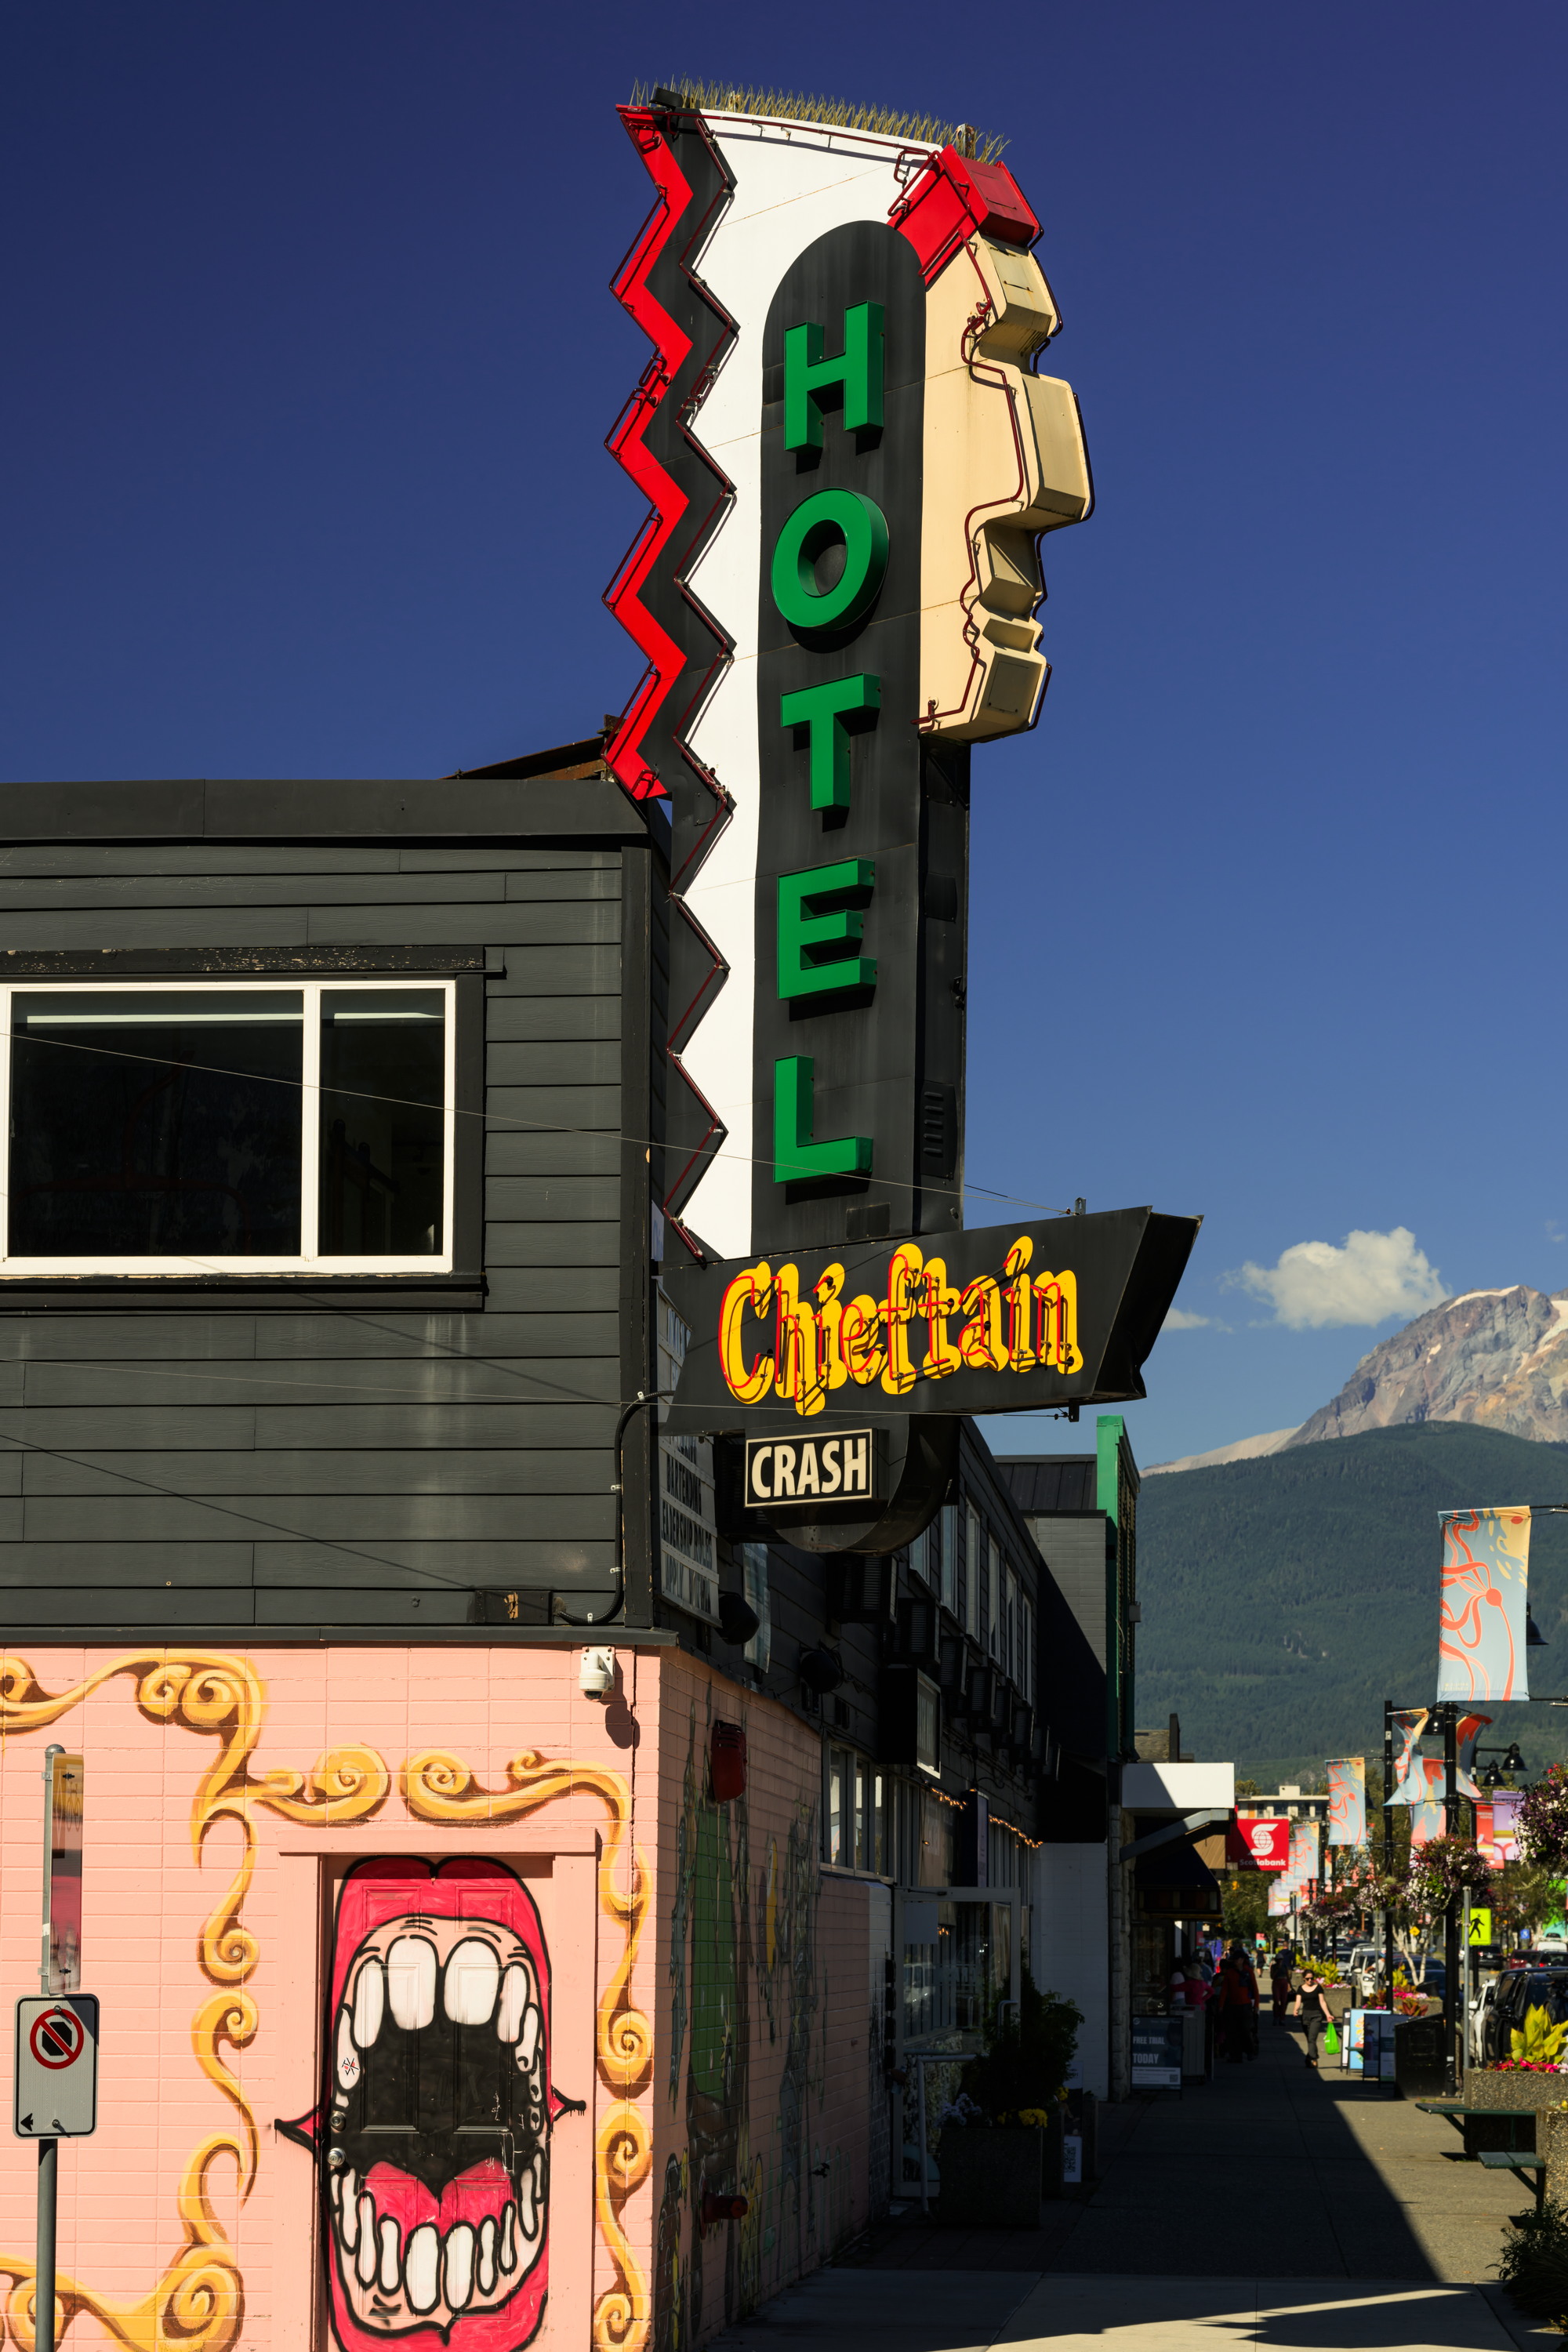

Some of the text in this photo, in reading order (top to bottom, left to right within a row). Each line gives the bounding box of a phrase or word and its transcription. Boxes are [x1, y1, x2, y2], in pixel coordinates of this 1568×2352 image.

[771, 300, 889, 1183] HOTEL
[719, 1236, 1083, 1416] Chieftain
[667, 1454, 702, 1515] BARTENDING
[750, 1438, 867, 1499] CRASH
[695, 1523, 713, 1571] ROLES
[1132, 2053, 1159, 2064] TODAY
